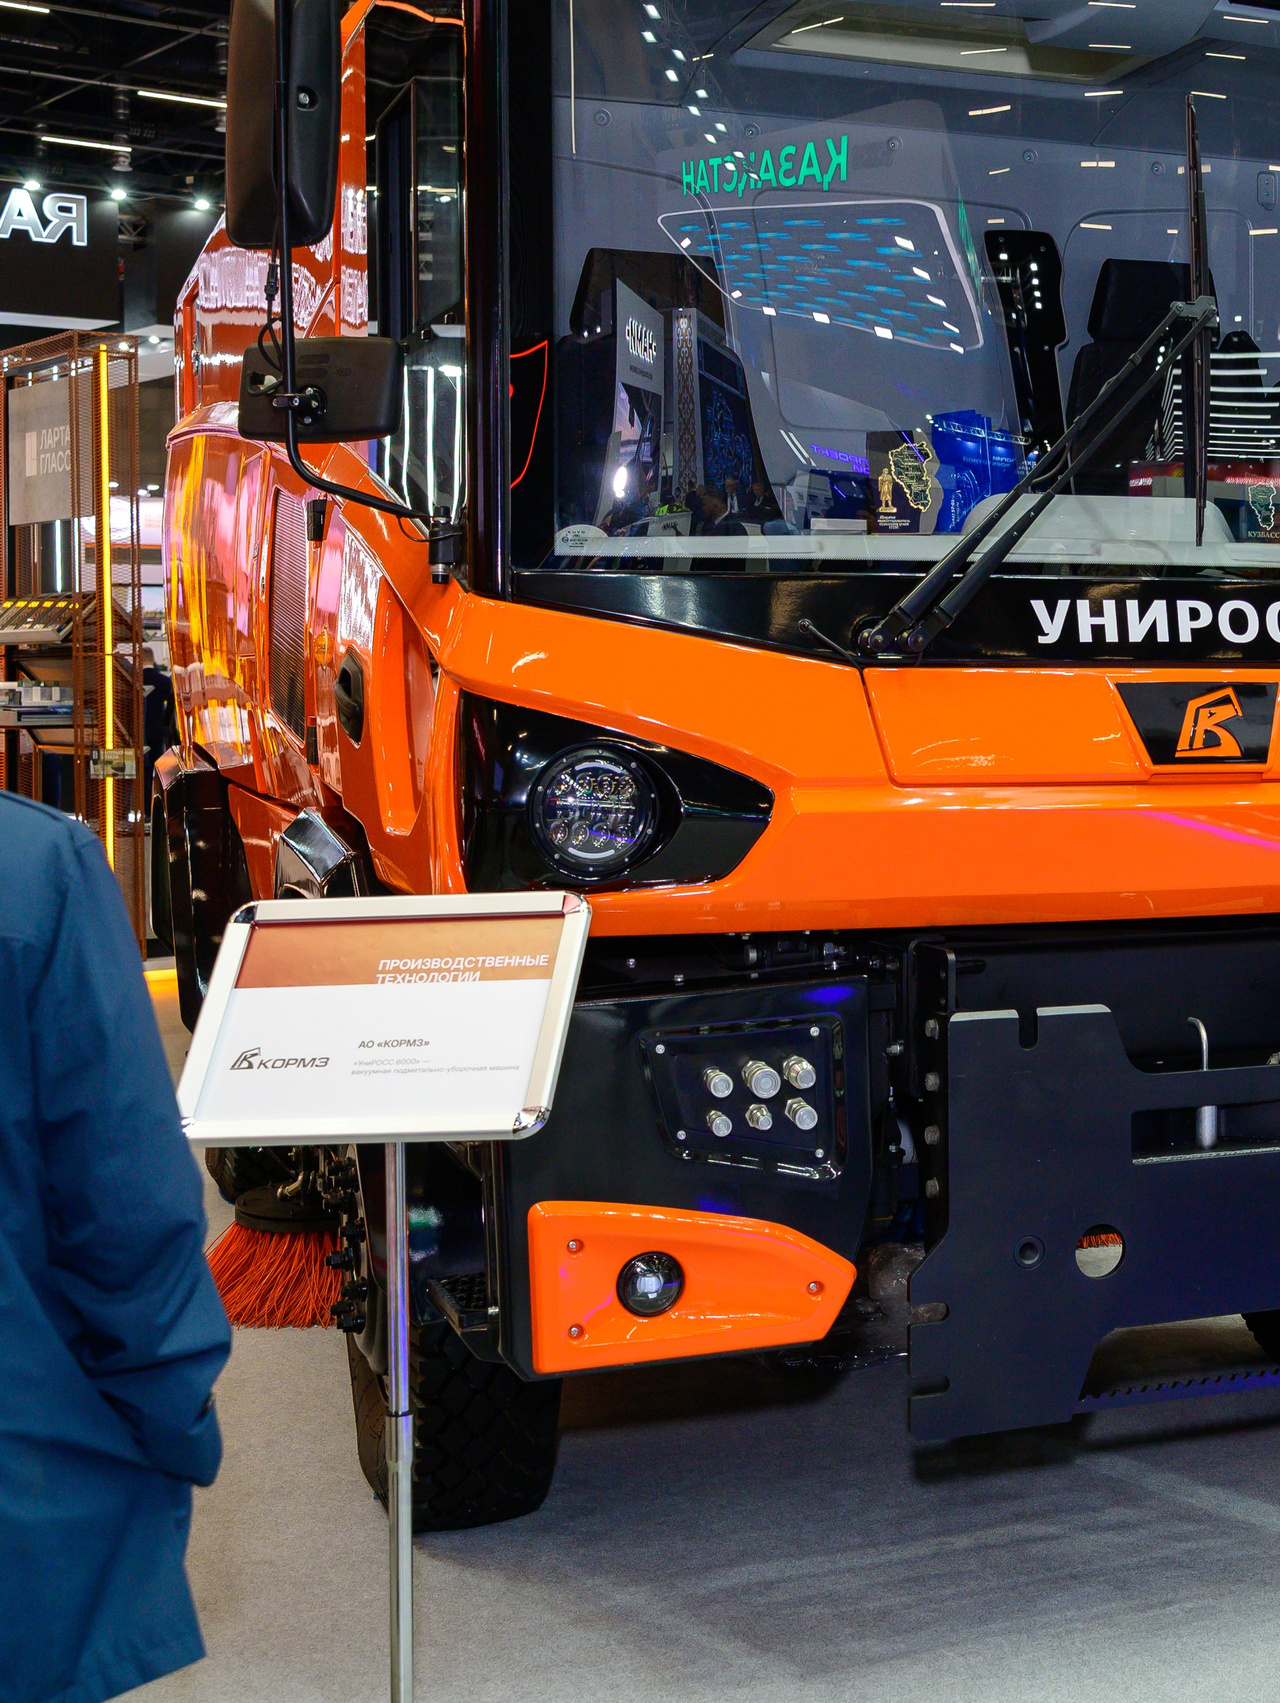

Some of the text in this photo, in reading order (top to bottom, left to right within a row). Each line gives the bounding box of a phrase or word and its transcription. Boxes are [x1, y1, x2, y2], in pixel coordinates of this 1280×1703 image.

[377, 954, 550, 971] ПРОИЗВОДСТВЕННЫЕ
[375, 970, 481, 984] ТЕХНОЛОГИИ
[357, 1038, 431, 1049] АО «КОРМЗ»
[257, 1056, 331, 1071] КОРМЗ
[351, 1067, 392, 1076] вакуумная
[488, 1064, 520, 1072] машина
